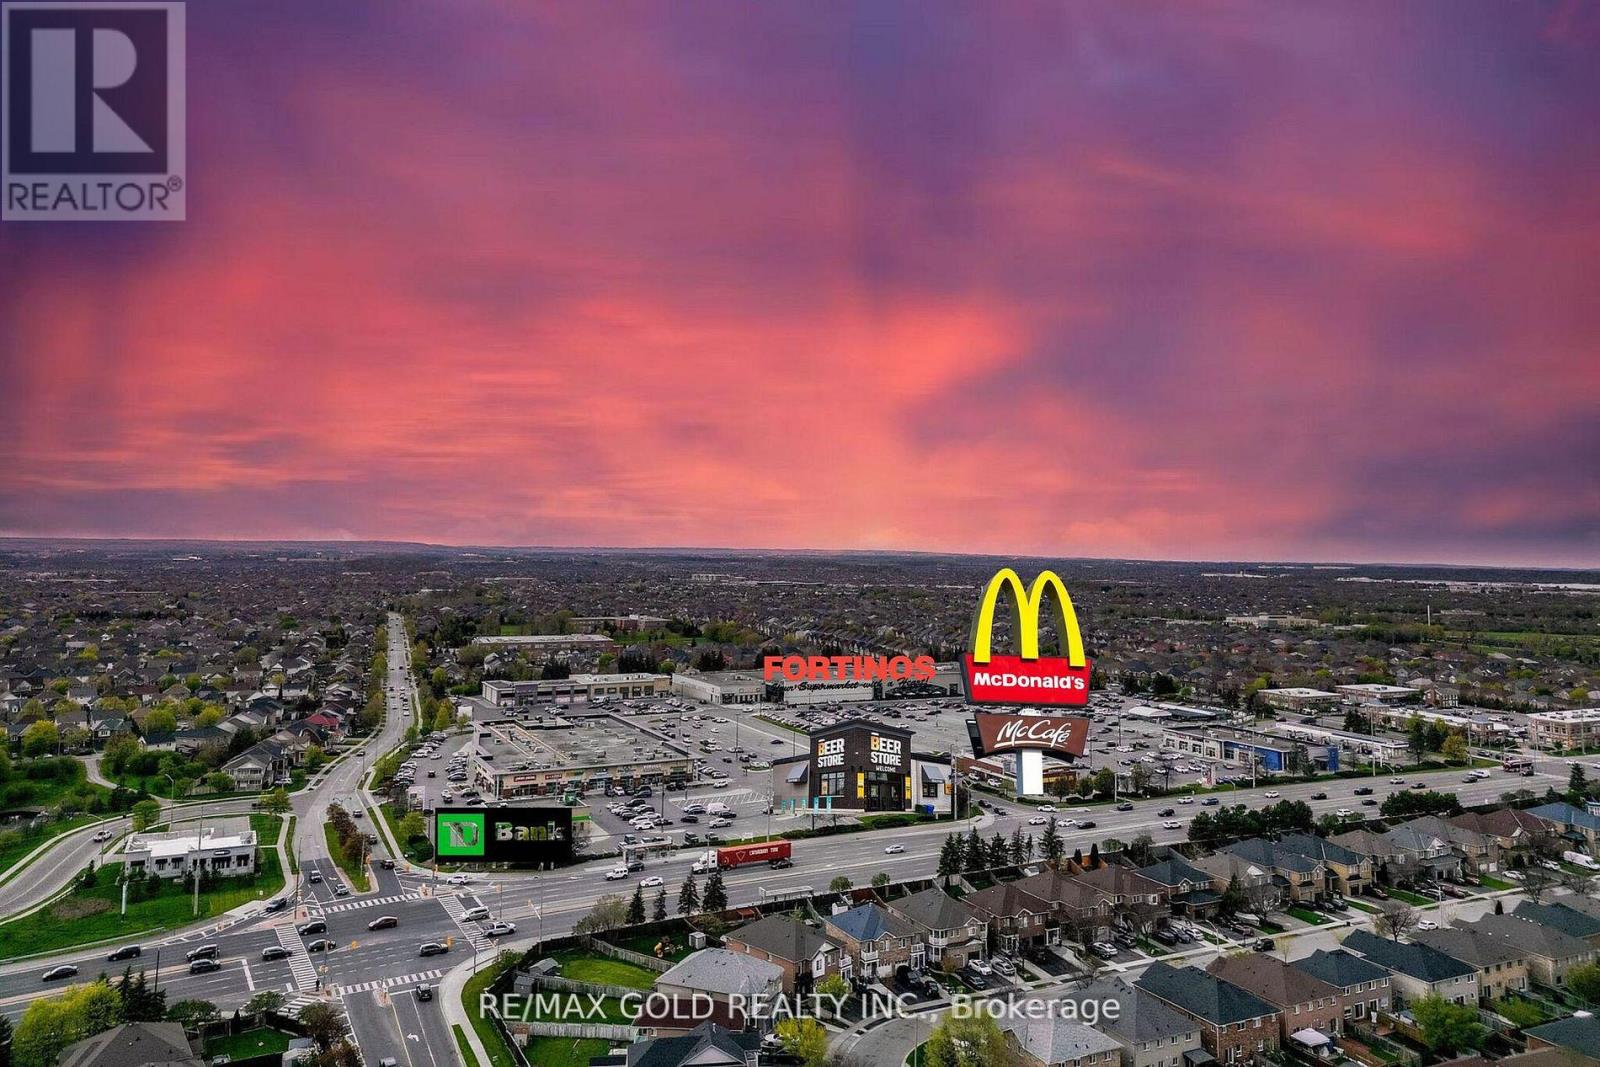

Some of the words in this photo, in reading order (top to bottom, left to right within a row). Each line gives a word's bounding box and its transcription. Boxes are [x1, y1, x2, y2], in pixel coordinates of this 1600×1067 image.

[763, 655, 937, 681] FORTINOS
[797, 680, 859, 692] Supermarket
[863, 679, 883, 689] with
[973, 672, 1085, 690] McDonald's
[996, 719, 1072, 748] McCafé
[818, 739, 845, 756] BEER
[871, 733, 902, 754] BEER
[817, 753, 845, 768] STORE
[871, 751, 902, 767] STORE
[875, 765, 897, 773] WELCOME
[442, 821, 480, 847] TD
[494, 820, 567, 841] Bank
